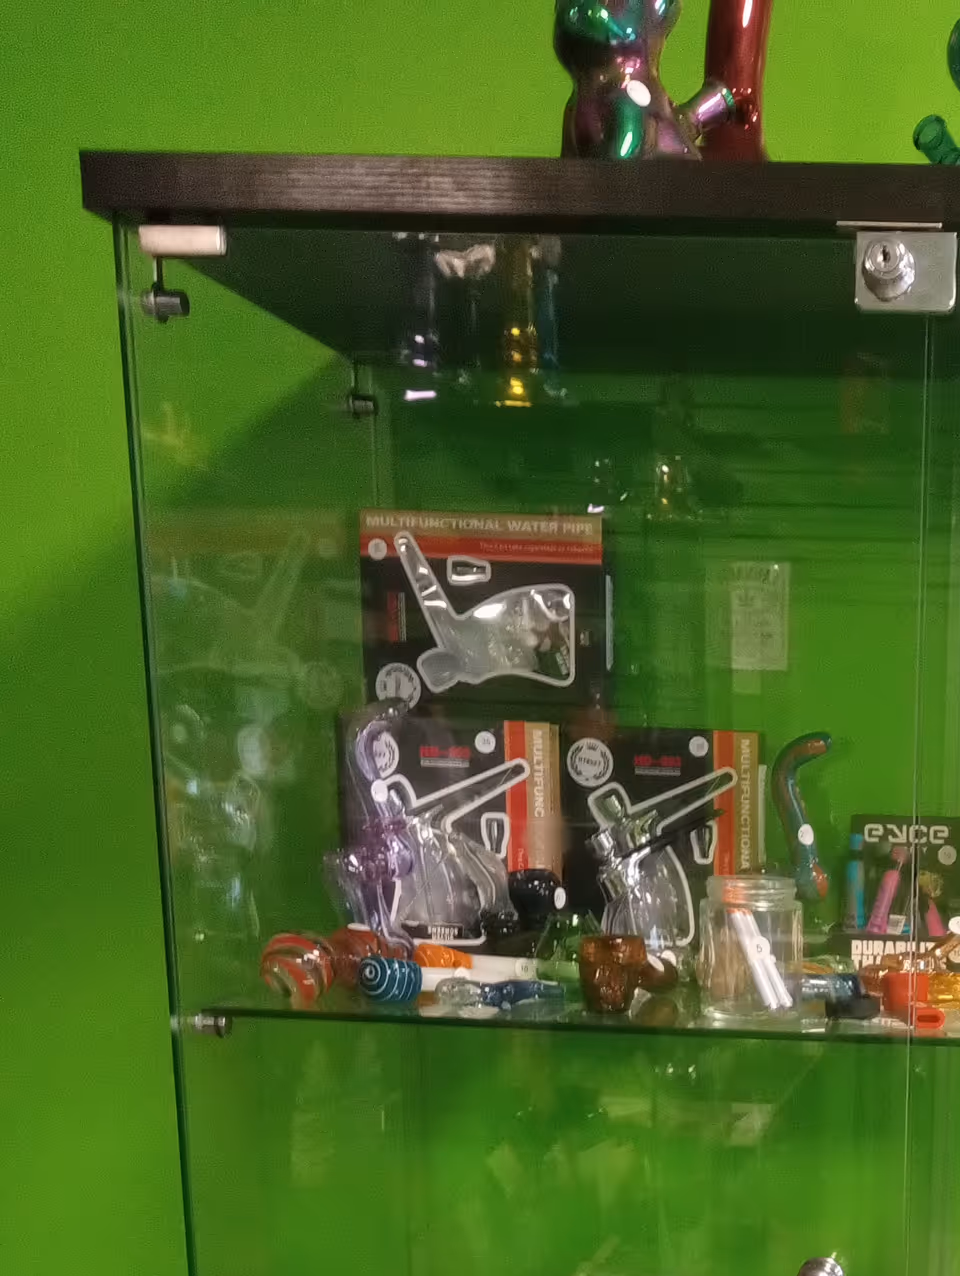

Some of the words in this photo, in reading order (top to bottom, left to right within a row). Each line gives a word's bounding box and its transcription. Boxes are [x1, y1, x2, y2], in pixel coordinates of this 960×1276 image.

[366, 514, 500, 532] MULTIFUNCTIONAL
[507, 519, 559, 534] WATER
[563, 522, 593, 536] PIPE
[533, 729, 546, 818] MULTIFUNC
[741, 738, 751, 869] MULTIFUNCTIONA
